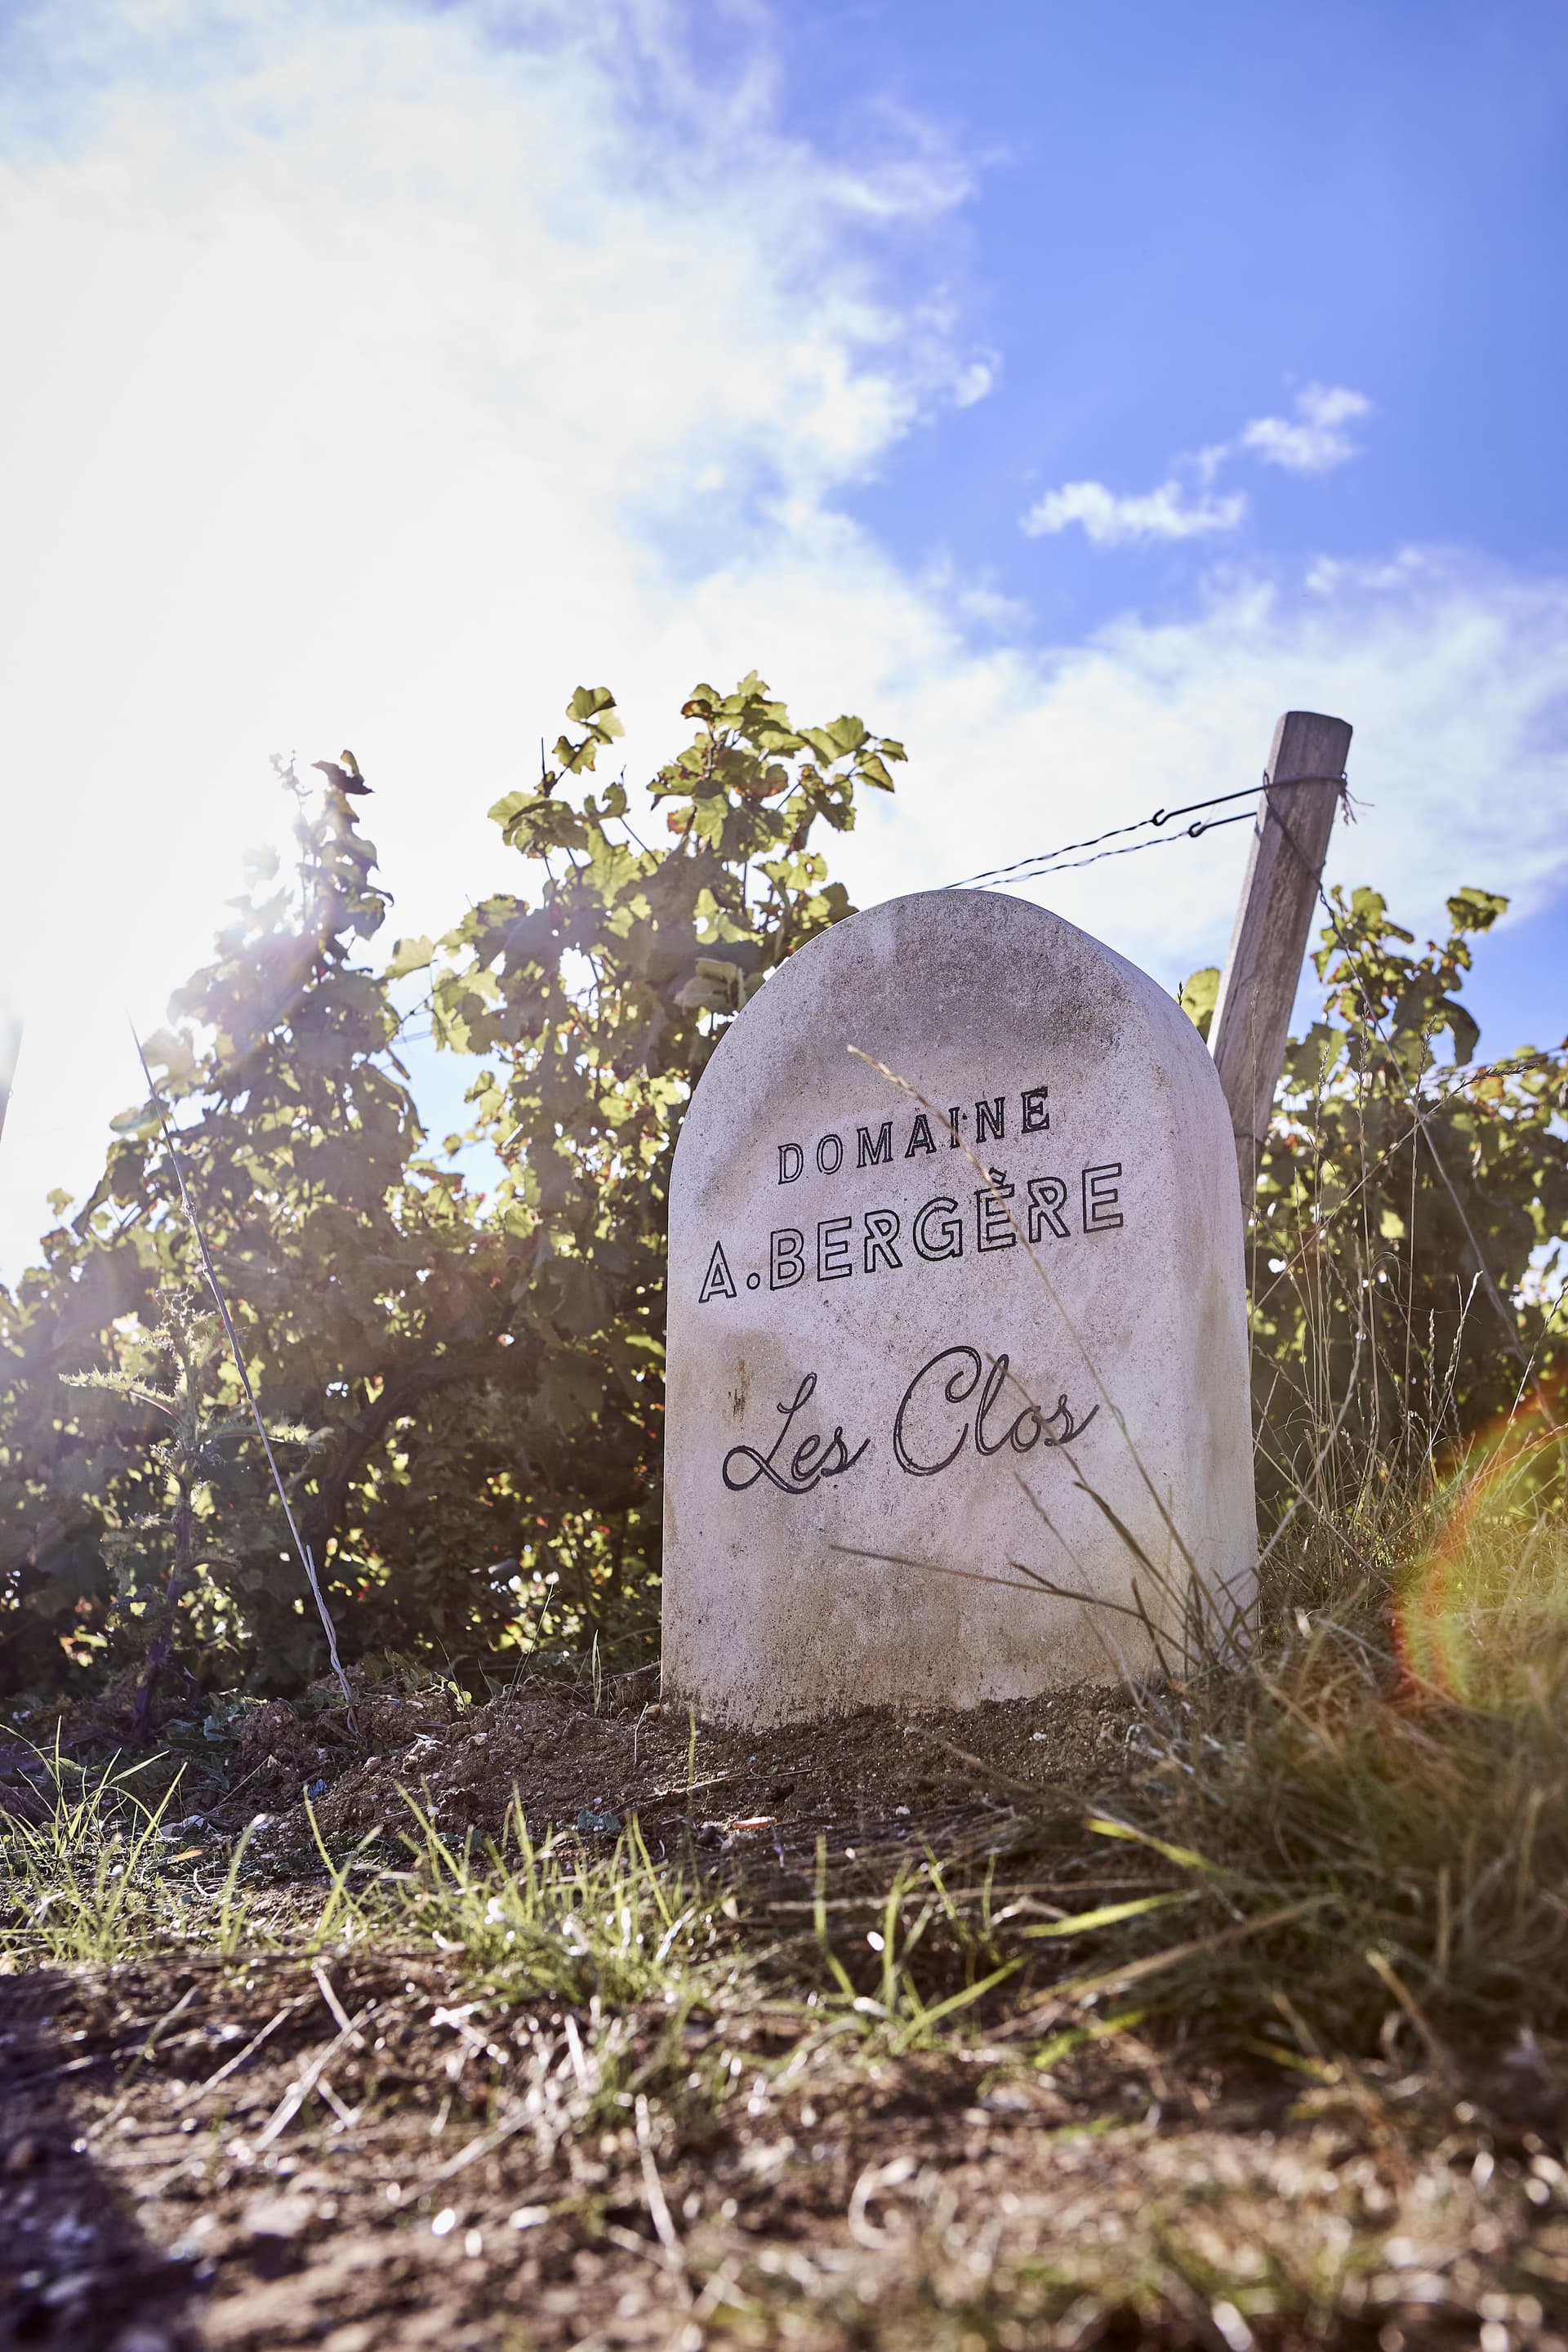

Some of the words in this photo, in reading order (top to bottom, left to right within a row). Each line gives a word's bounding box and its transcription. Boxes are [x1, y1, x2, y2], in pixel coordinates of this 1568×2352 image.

[777, 1086, 1050, 1185] DOMAINE
[723, 1371, 871, 1494] Les
[893, 1346, 1099, 1477] Clos
